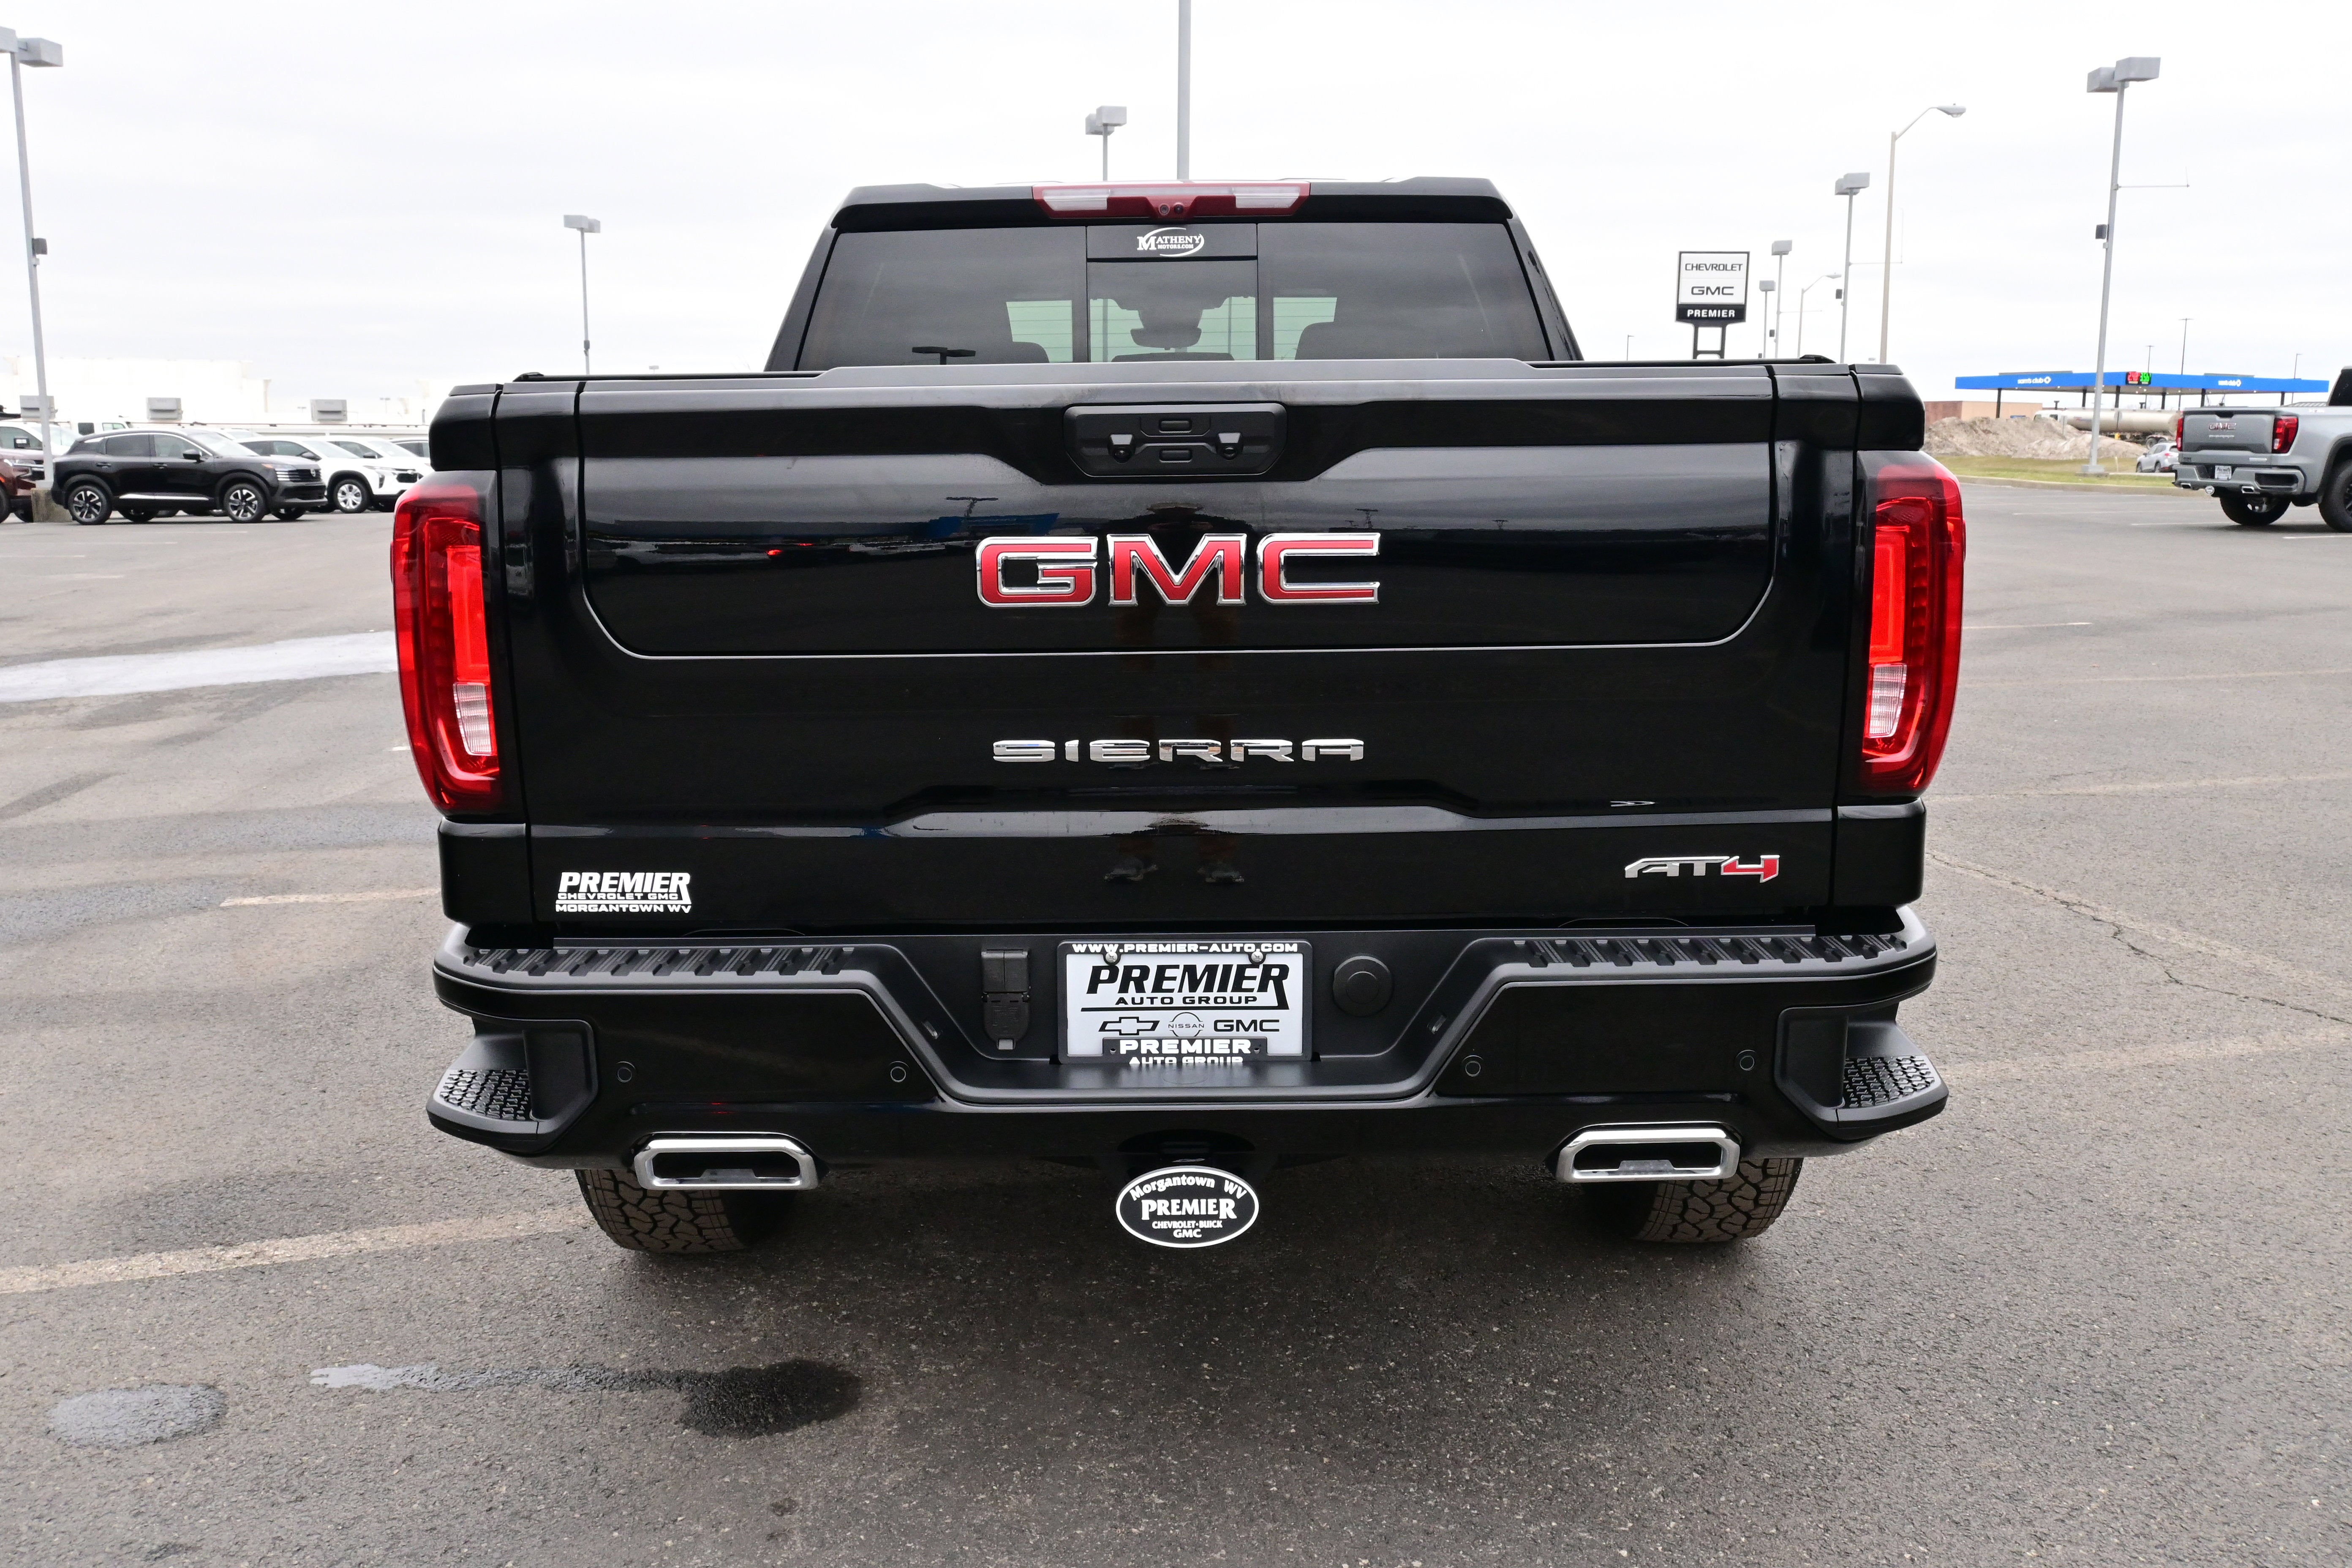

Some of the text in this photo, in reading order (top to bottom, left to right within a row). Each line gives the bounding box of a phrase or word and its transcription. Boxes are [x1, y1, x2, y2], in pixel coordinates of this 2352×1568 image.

[1137, 236, 1201, 250] MATHENY
[1685, 263, 1743, 271] CHEVROLET
[1691, 286, 1734, 295] GMC
[976, 533, 1381, 607] GMC
[992, 738, 1364, 763] SIERRA
[1625, 855, 1780, 883] AT4
[558, 872, 691, 901] PREMIER
[555, 904, 691, 914] MORGANTOWN WV
[1072, 943, 1298, 953] WWW.PREMIER-AUTO.COM
[1086, 964, 1290, 1008] PREMIER
[1115, 996, 1258, 1005] AUTO GROUP
[1214, 1019, 1279, 1032] GMC
[1120, 1039, 1251, 1054] PREMIER
[1129, 1174, 1247, 1201] Morgantown WV
[1141, 1198, 1237, 1220] PREMIER
[1173, 1229, 1202, 1238] GMC
